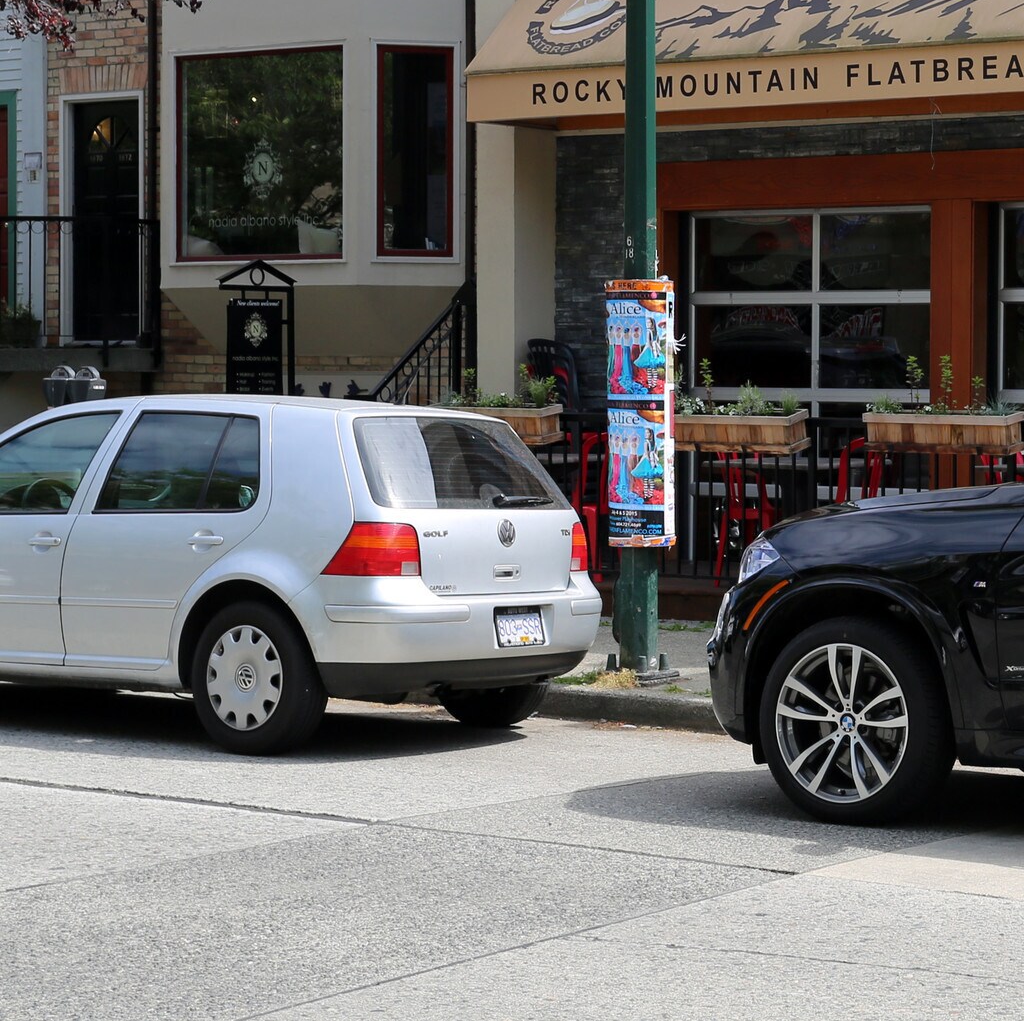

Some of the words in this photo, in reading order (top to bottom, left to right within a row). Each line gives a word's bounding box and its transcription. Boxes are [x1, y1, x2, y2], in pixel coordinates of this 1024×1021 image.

[530, 26, 594, 53] FLATBREAD
[532, 79, 626, 105] ROCKY
[656, 67, 819, 99] MOUNTAIN
[258, 161, 269, 176] N
[208, 215, 238, 228] nadia
[240, 214, 277, 227] albano
[278, 214, 300, 229] style
[626, 235, 632, 247] 6
[625, 248, 634, 259] 18
[610, 302, 642, 315] Alice
[610, 410, 640, 425] Alice
[423, 530, 449, 538] GOLF
